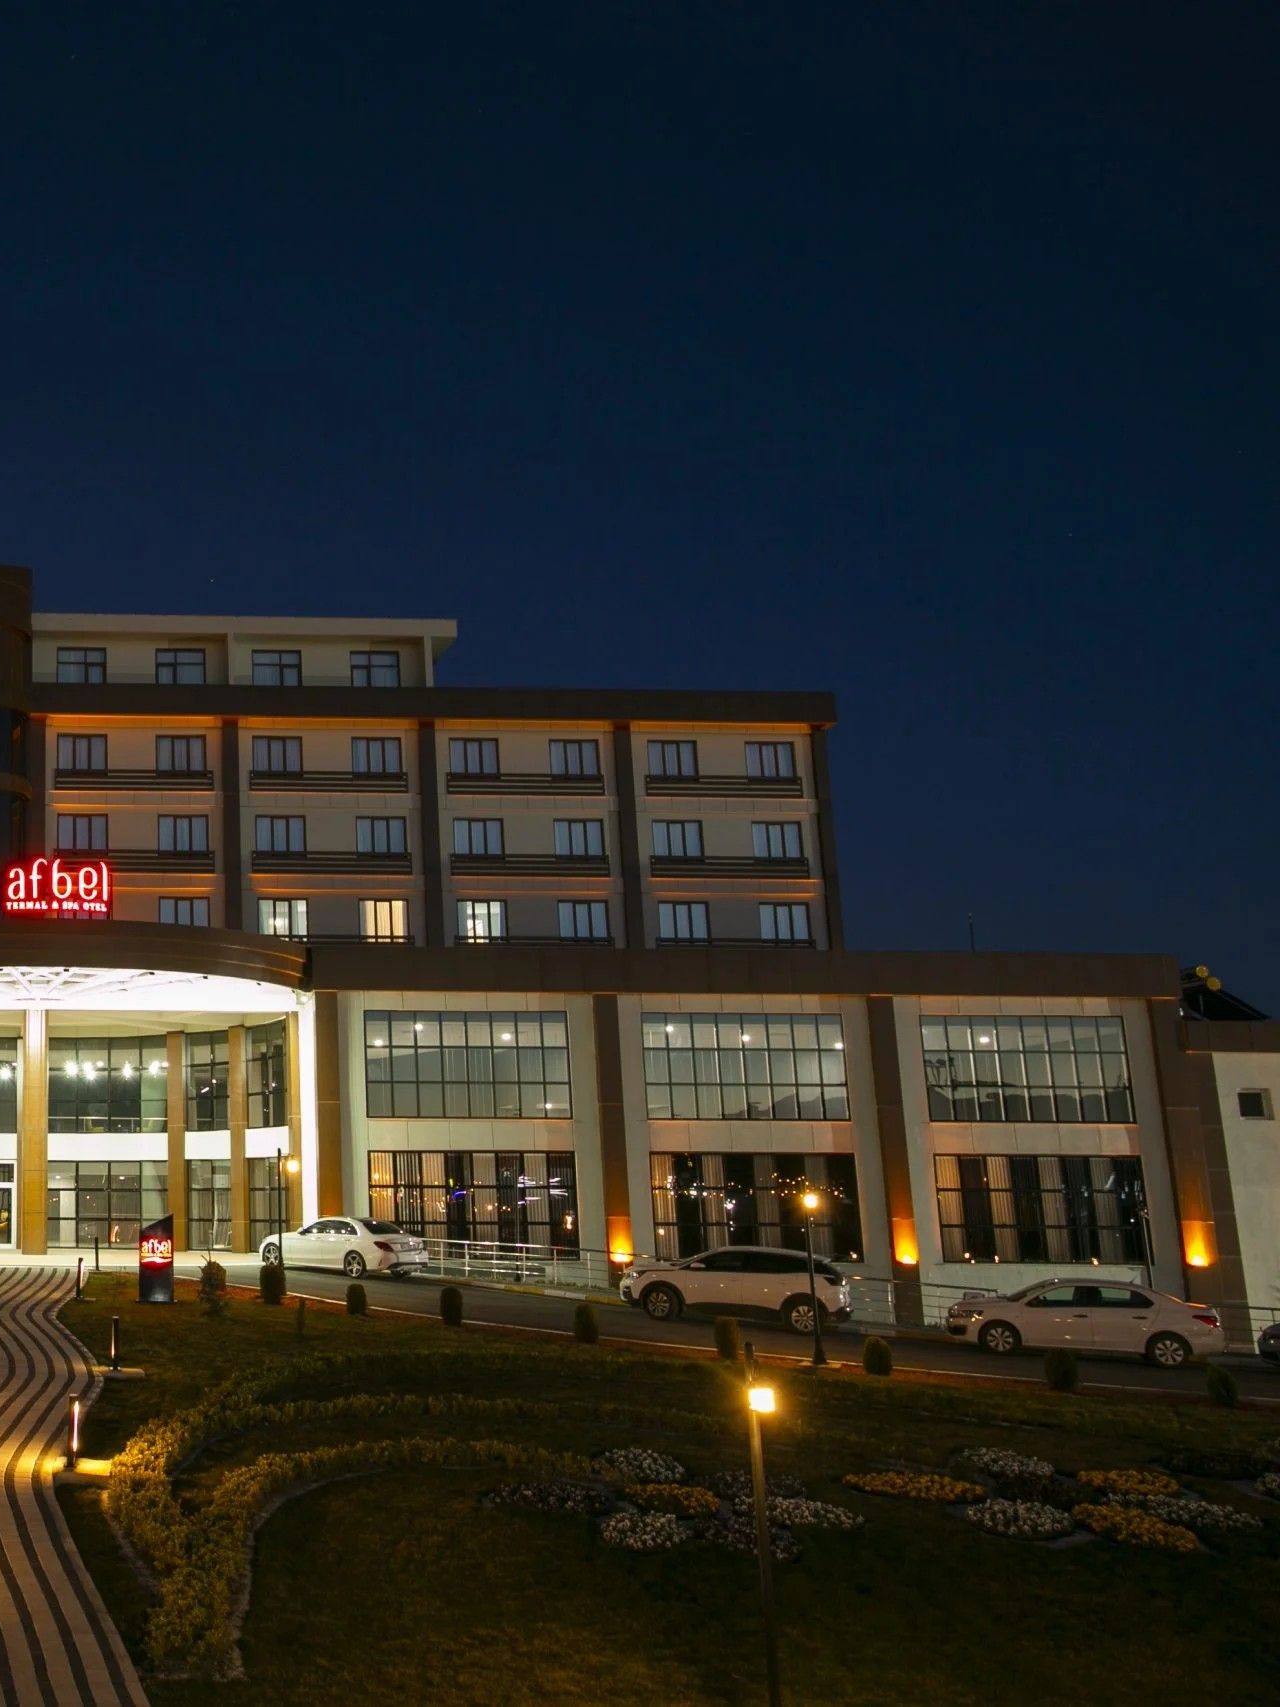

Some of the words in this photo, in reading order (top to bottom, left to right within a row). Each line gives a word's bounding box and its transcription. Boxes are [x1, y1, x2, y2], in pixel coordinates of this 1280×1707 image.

[7, 858, 108, 901] afbel
[62, 901, 79, 910] SPA
[83, 902, 107, 912] OTEL
[141, 1239, 172, 1253] afbel
